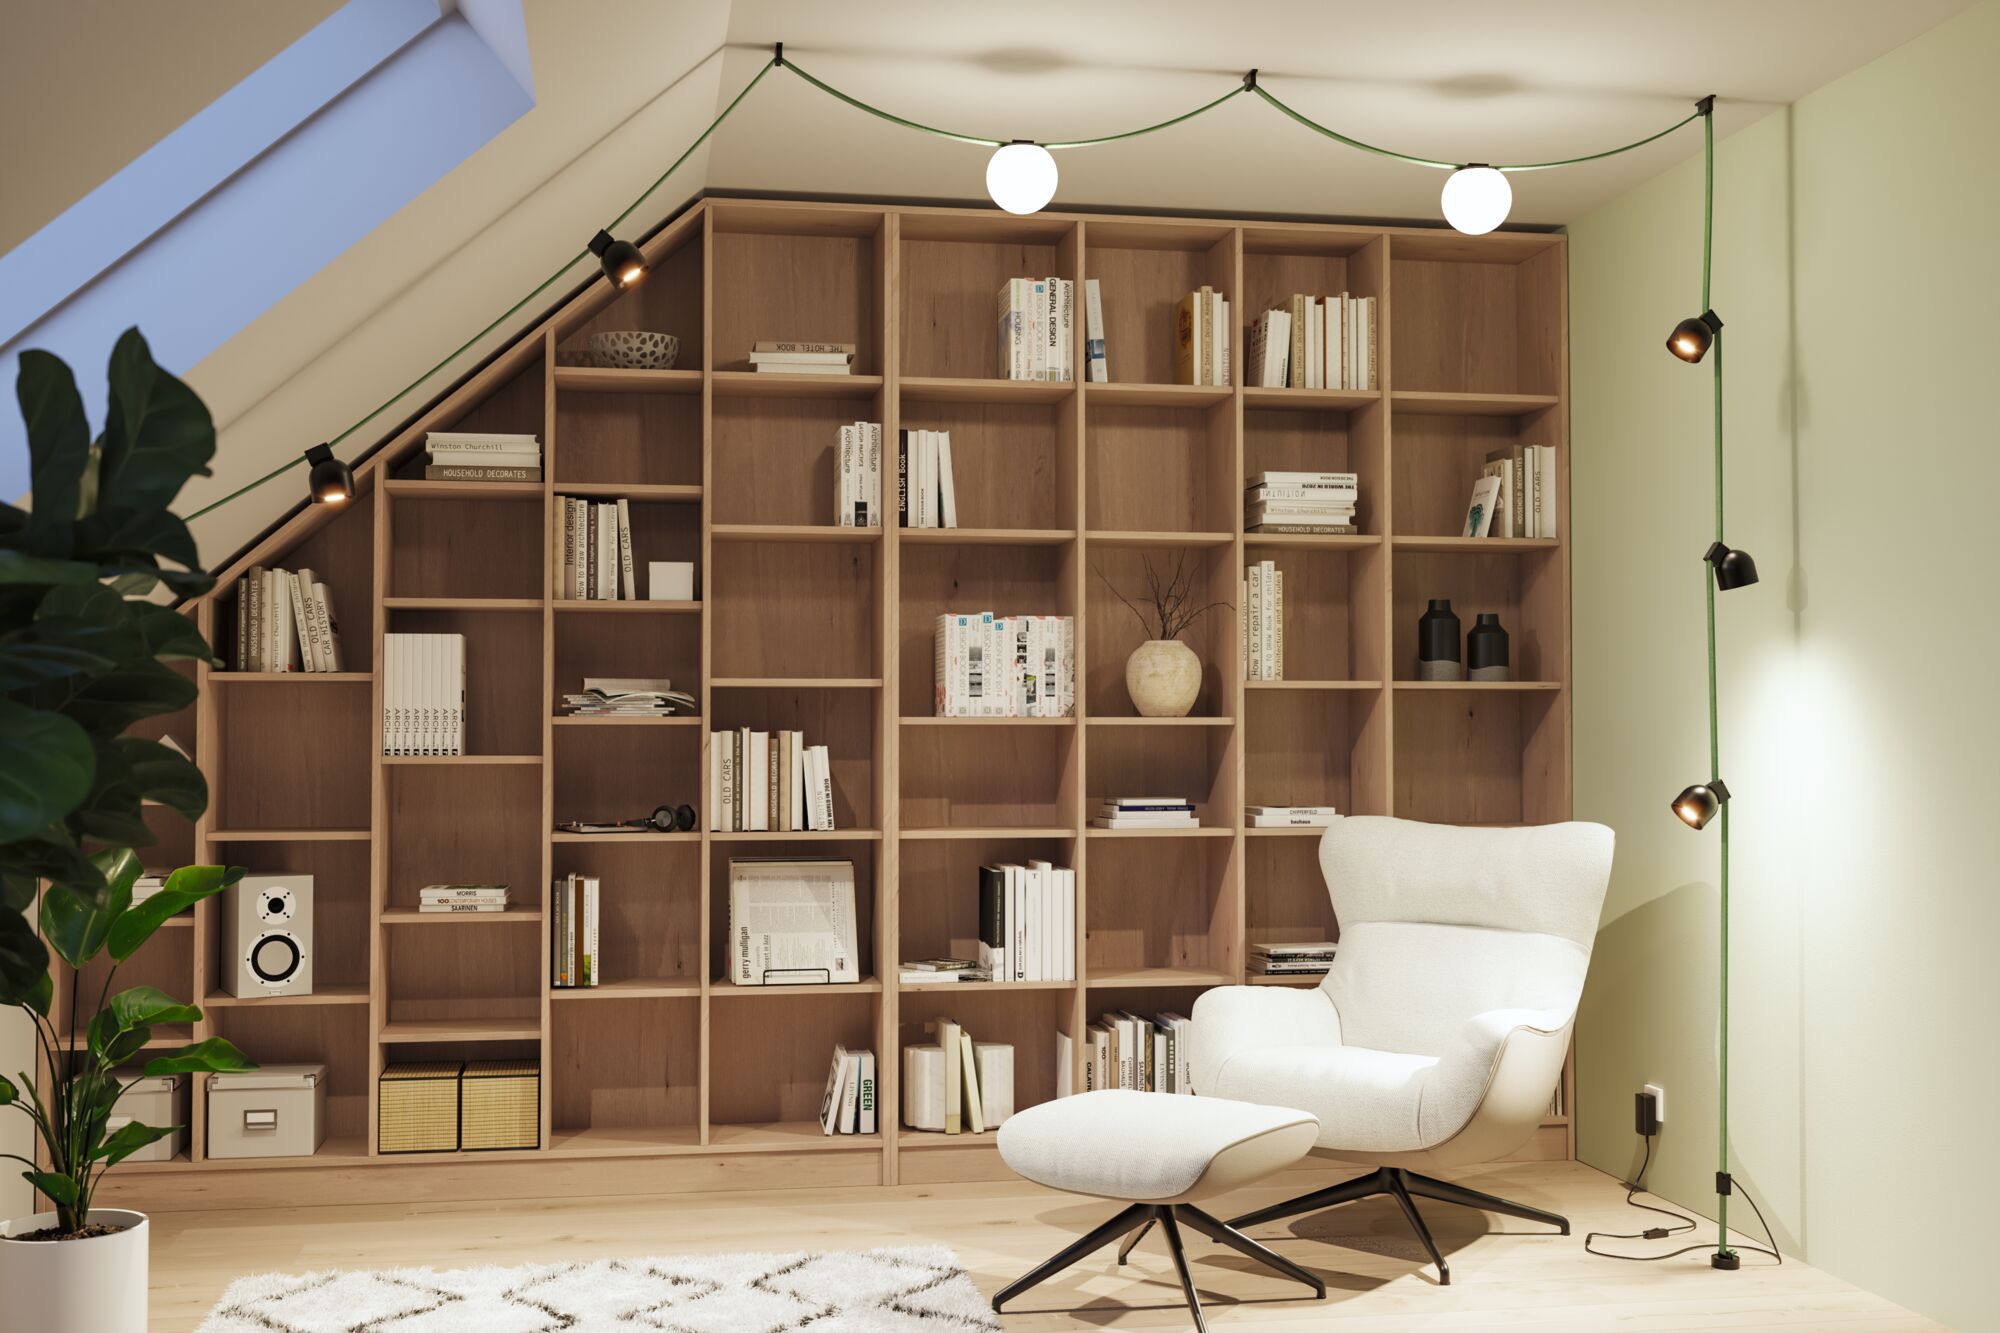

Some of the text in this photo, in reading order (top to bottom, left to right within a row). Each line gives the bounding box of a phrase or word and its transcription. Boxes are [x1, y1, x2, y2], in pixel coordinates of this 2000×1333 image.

[443, 469, 526, 478] HOUSEHOLD DECORATES
[565, 501, 576, 565] Interior design
[577, 504, 585, 548] architecture
[621, 527, 632, 572] OLD CARS
[304, 597, 319, 644] OLD CARS
[316, 600, 332, 655] CAR HISTORY
[1251, 605, 1260, 637] repair
[1251, 643, 1259, 652] to
[1251, 659, 1259, 676] How
[1267, 654, 1272, 662] TO
[723, 758, 731, 804] OLD CARS
[817, 791, 826, 828] INTUITION
[739, 926, 751, 979] gerry mulligan
[863, 1080, 872, 1110] GREEN
